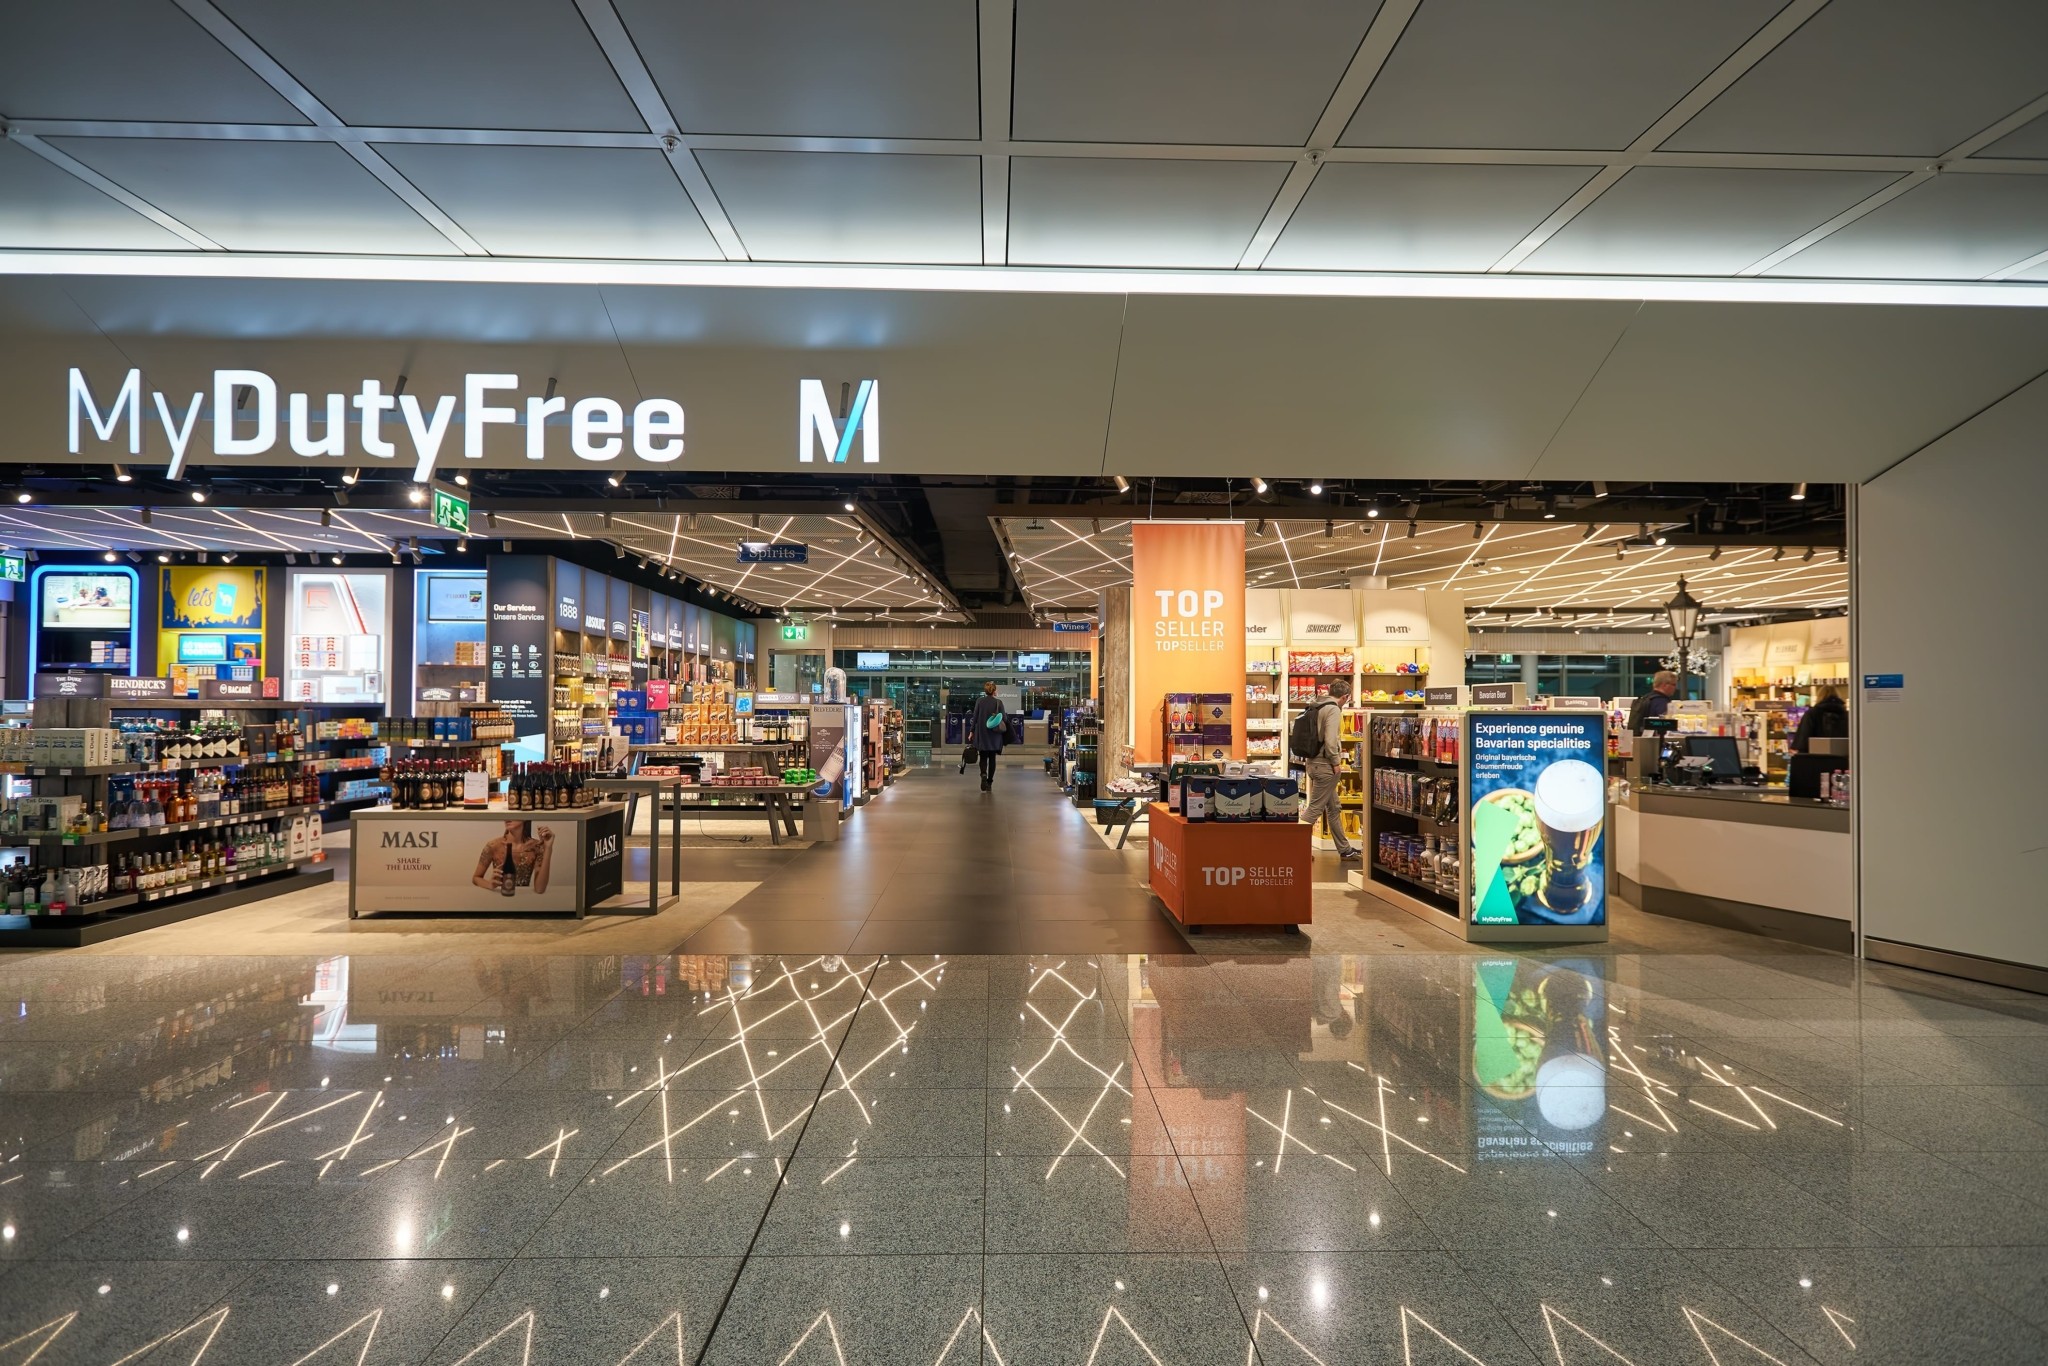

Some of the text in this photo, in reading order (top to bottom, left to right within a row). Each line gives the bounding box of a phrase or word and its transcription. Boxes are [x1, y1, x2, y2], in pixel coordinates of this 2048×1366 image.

[69, 367, 685, 482] MyDutyFree
[749, 546, 795, 560] Spirits
[560, 603, 578, 619] 1888
[1154, 590, 1224, 618] TOP
[1155, 621, 1224, 637] SELLER
[1306, 624, 1342, 633] SNICKERS
[1155, 641, 1224, 651] TOPSELLER
[110, 679, 166, 689] HENDRICK'S
[1479, 690, 1507, 699] Bavarian Beer
[1475, 723, 1584, 736] Experience genuine
[1475, 738, 1591, 751] Bavarian specialities
[380, 831, 439, 848] MASI
[594, 834, 616, 859] MASI
[1153, 837, 1177, 872] TOP SELLER
[1202, 867, 1294, 885] TOP SELLER
